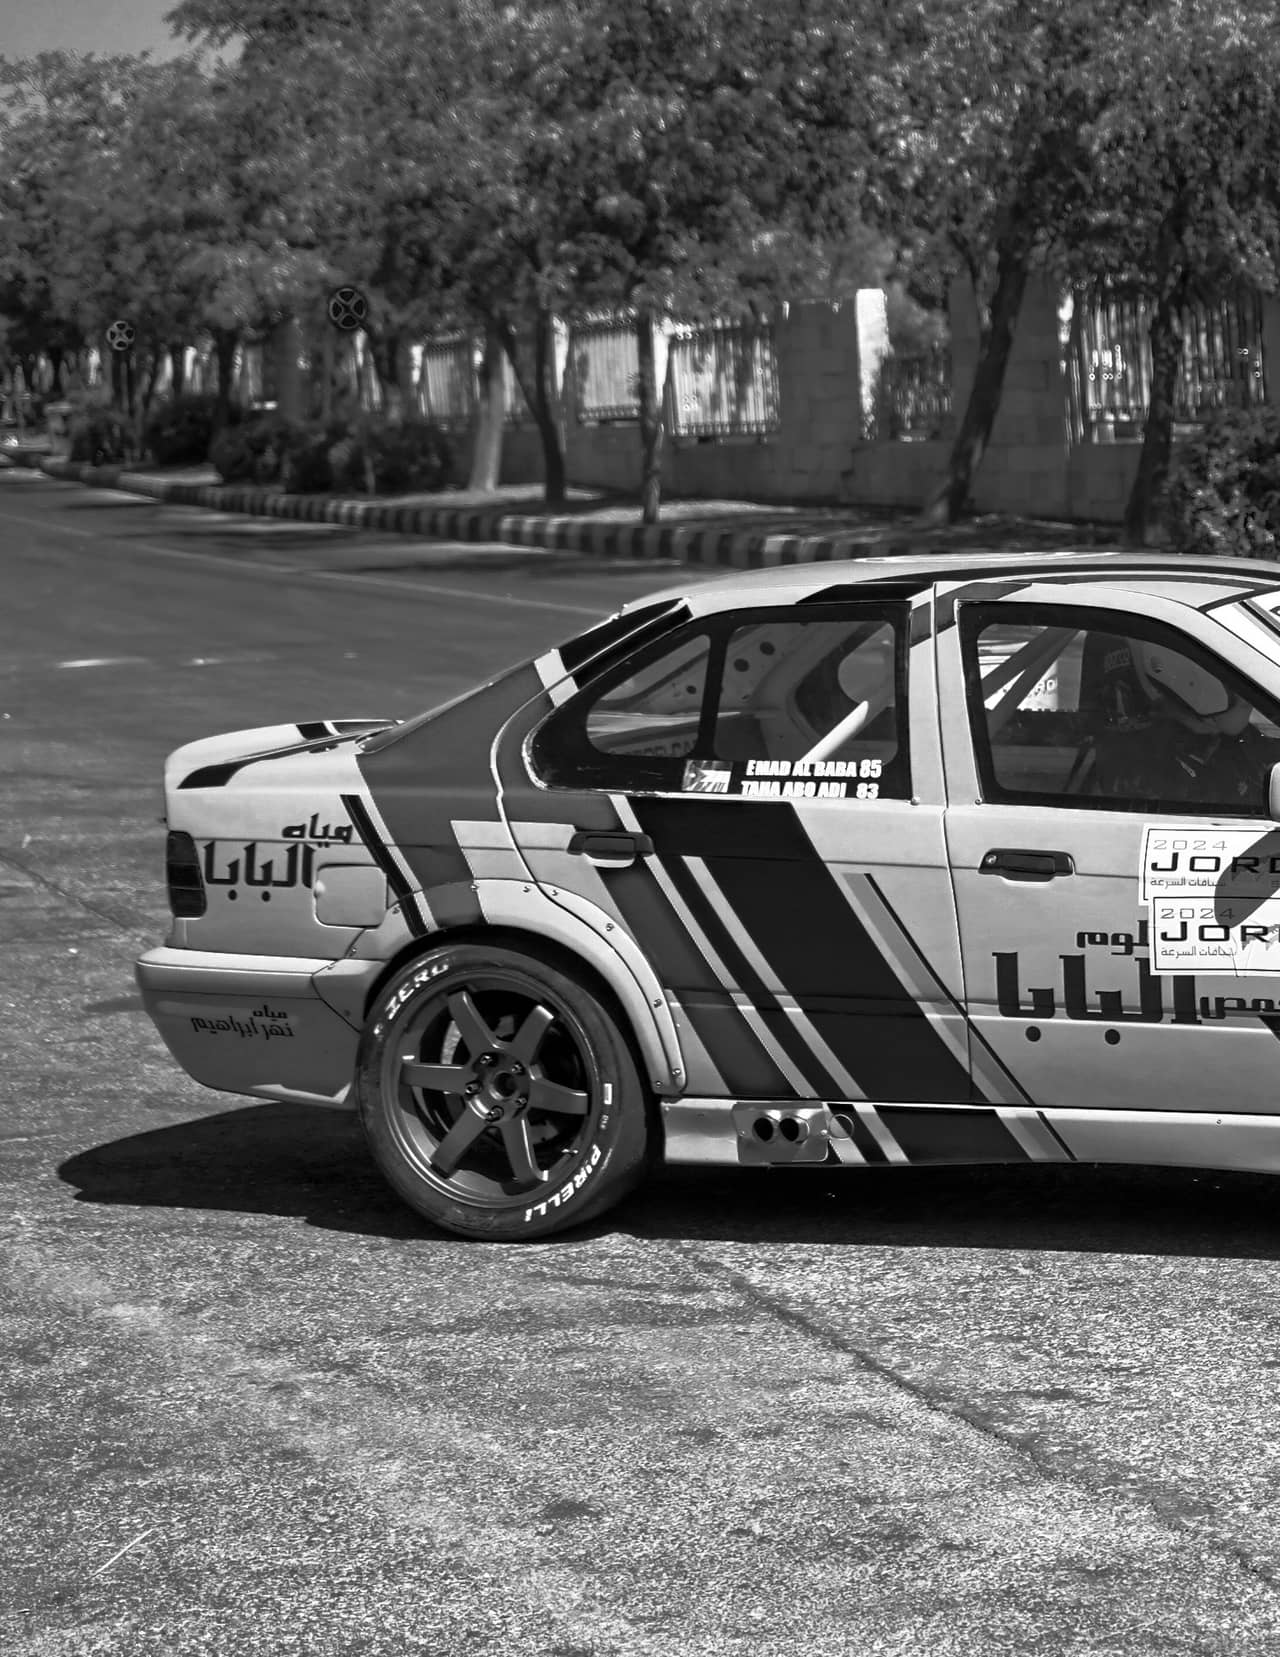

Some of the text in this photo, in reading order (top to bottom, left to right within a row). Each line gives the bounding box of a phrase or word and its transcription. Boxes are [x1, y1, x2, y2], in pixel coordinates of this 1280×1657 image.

[745, 759, 882, 778] EMAD AL BABA 85
[781, 780, 816, 797] ABO
[818, 781, 847, 798] ADI
[856, 783, 879, 799] 83
[282, 813, 352, 848] مياه
[1153, 840, 1227, 851] 2024
[203, 839, 316, 902] البابا
[1161, 908, 1235, 920] 2024
[992, 952, 1202, 1045] البابا
[524, 1144, 601, 1222] PIRELLI
